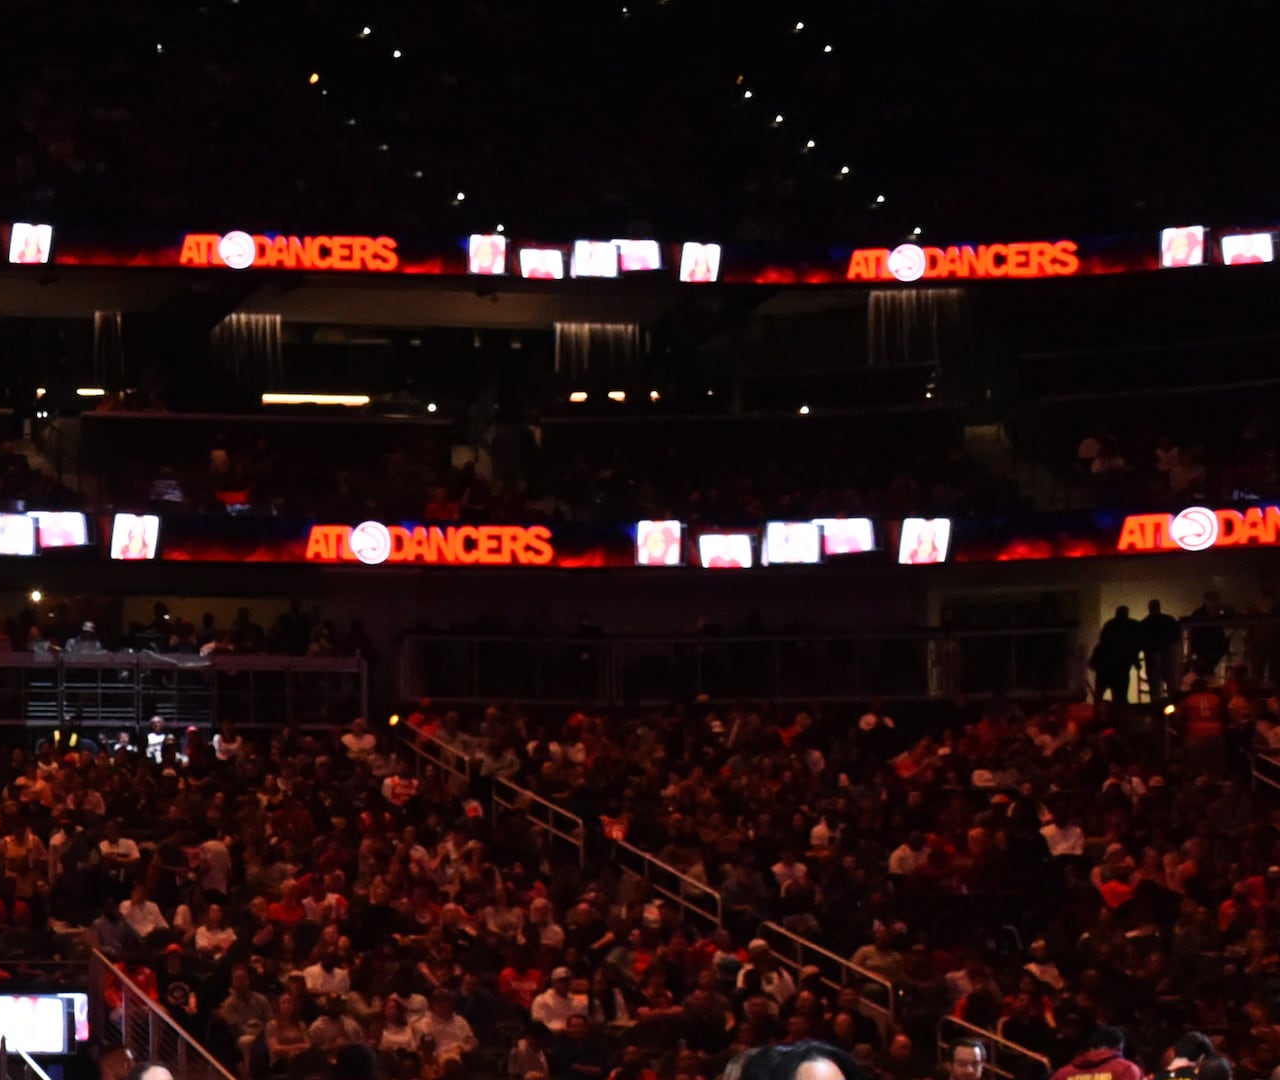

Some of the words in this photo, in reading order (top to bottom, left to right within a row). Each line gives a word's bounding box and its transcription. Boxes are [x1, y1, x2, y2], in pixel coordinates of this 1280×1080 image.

[254, 235, 398, 271] DANCERS
[925, 240, 1079, 279] DANCERS
[389, 525, 553, 565] DANCERS
